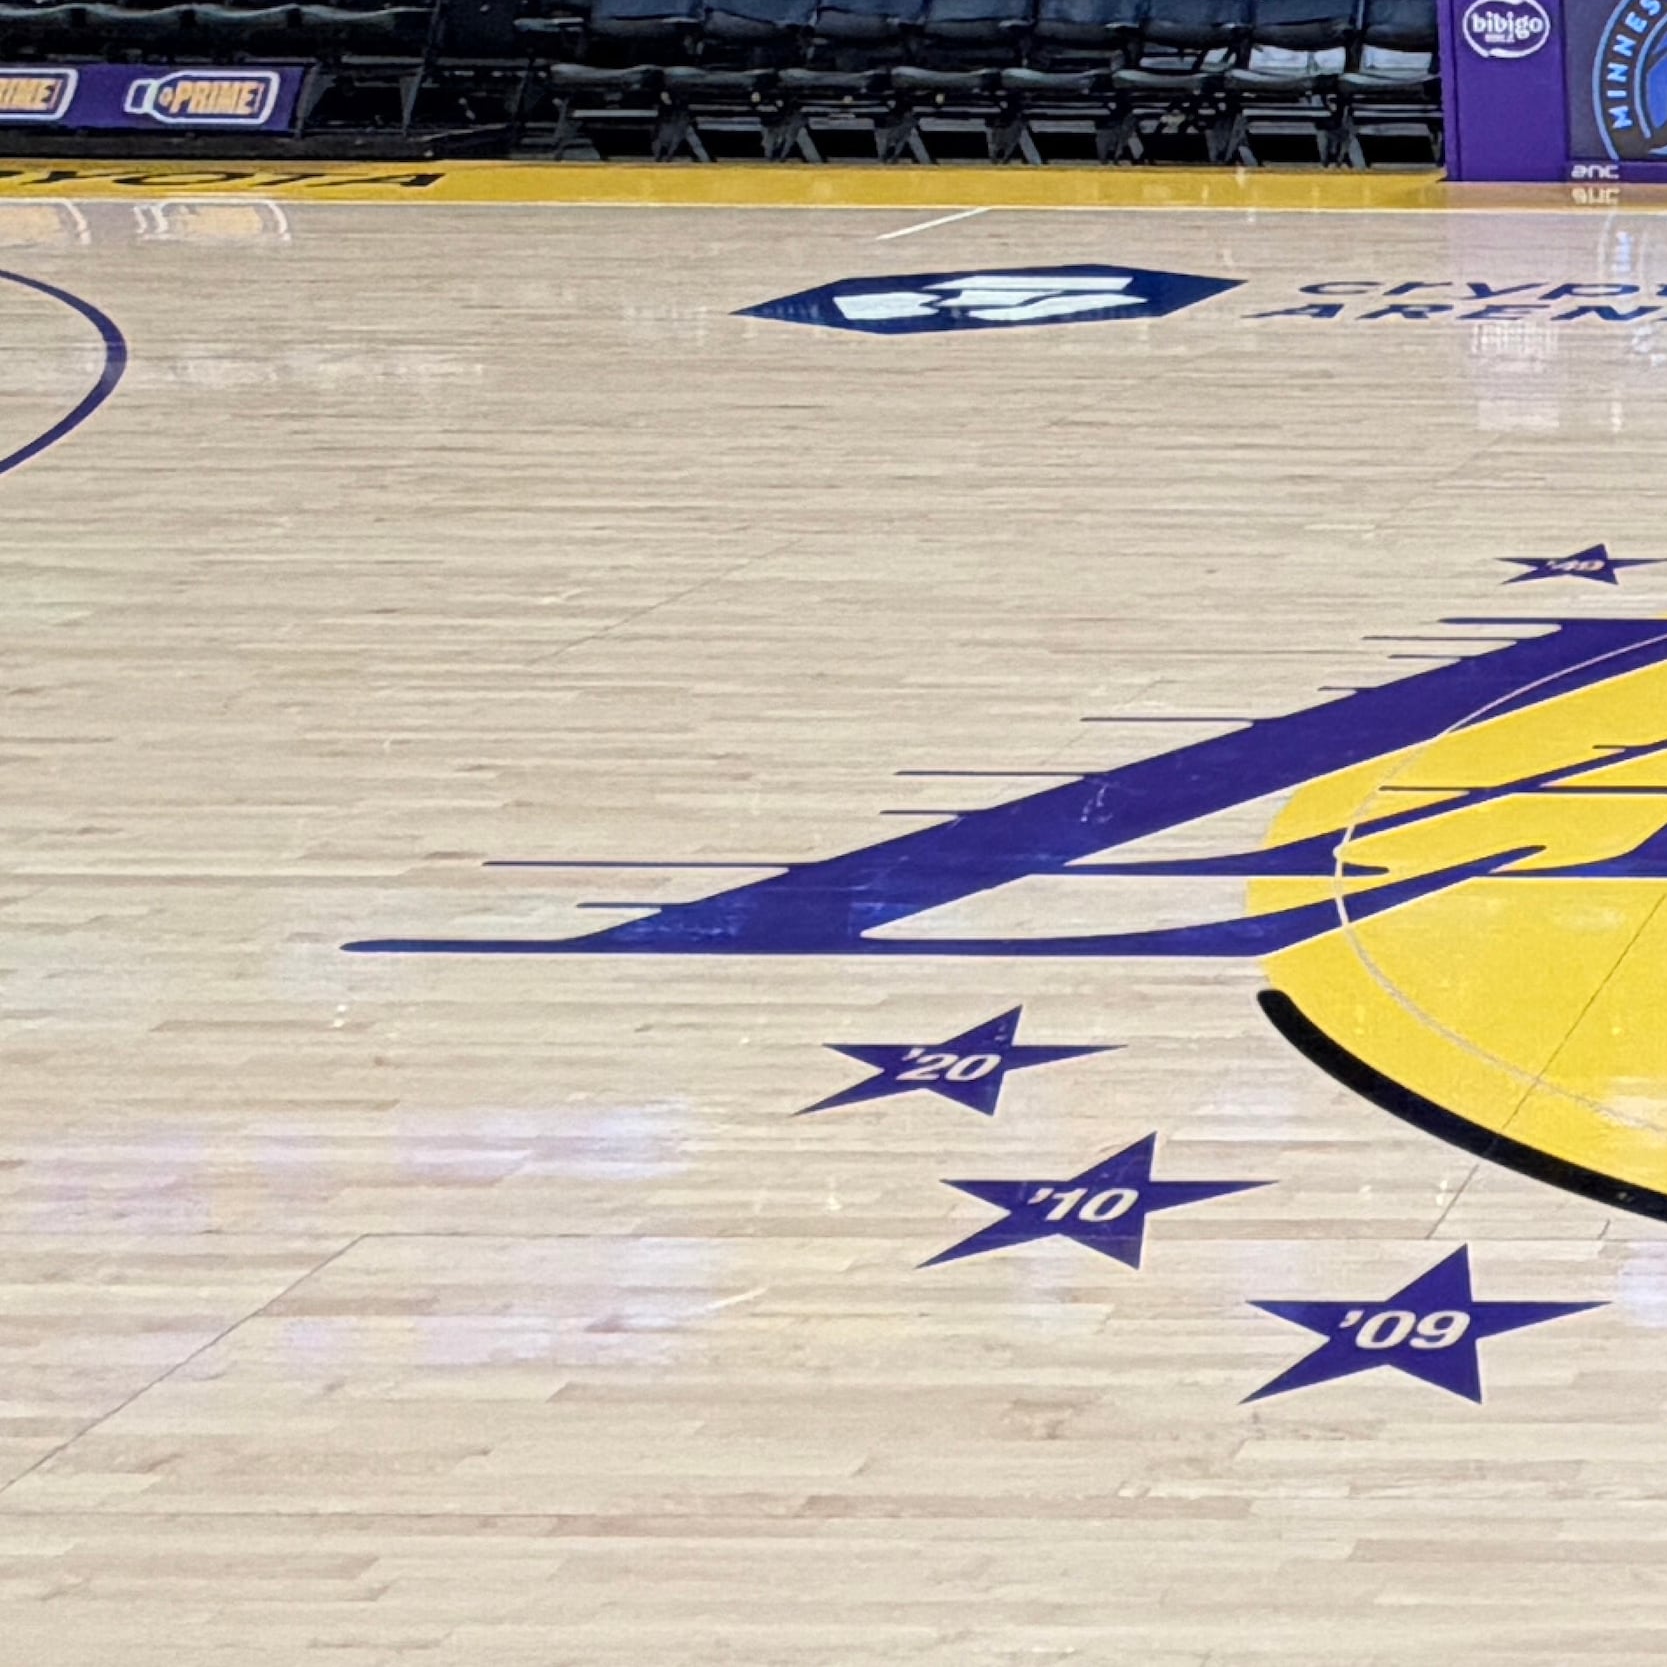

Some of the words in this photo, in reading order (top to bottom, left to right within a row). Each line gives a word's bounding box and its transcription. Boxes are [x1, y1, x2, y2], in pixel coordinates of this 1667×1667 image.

[1472, 11, 1545, 40] bibigo
[170, 80, 258, 115] PRIME
[0, 170, 446, 187] YOTA
[896, 1047, 1002, 1082] '20
[1027, 1187, 1140, 1222] '10
[1338, 1308, 1471, 1351] '09
